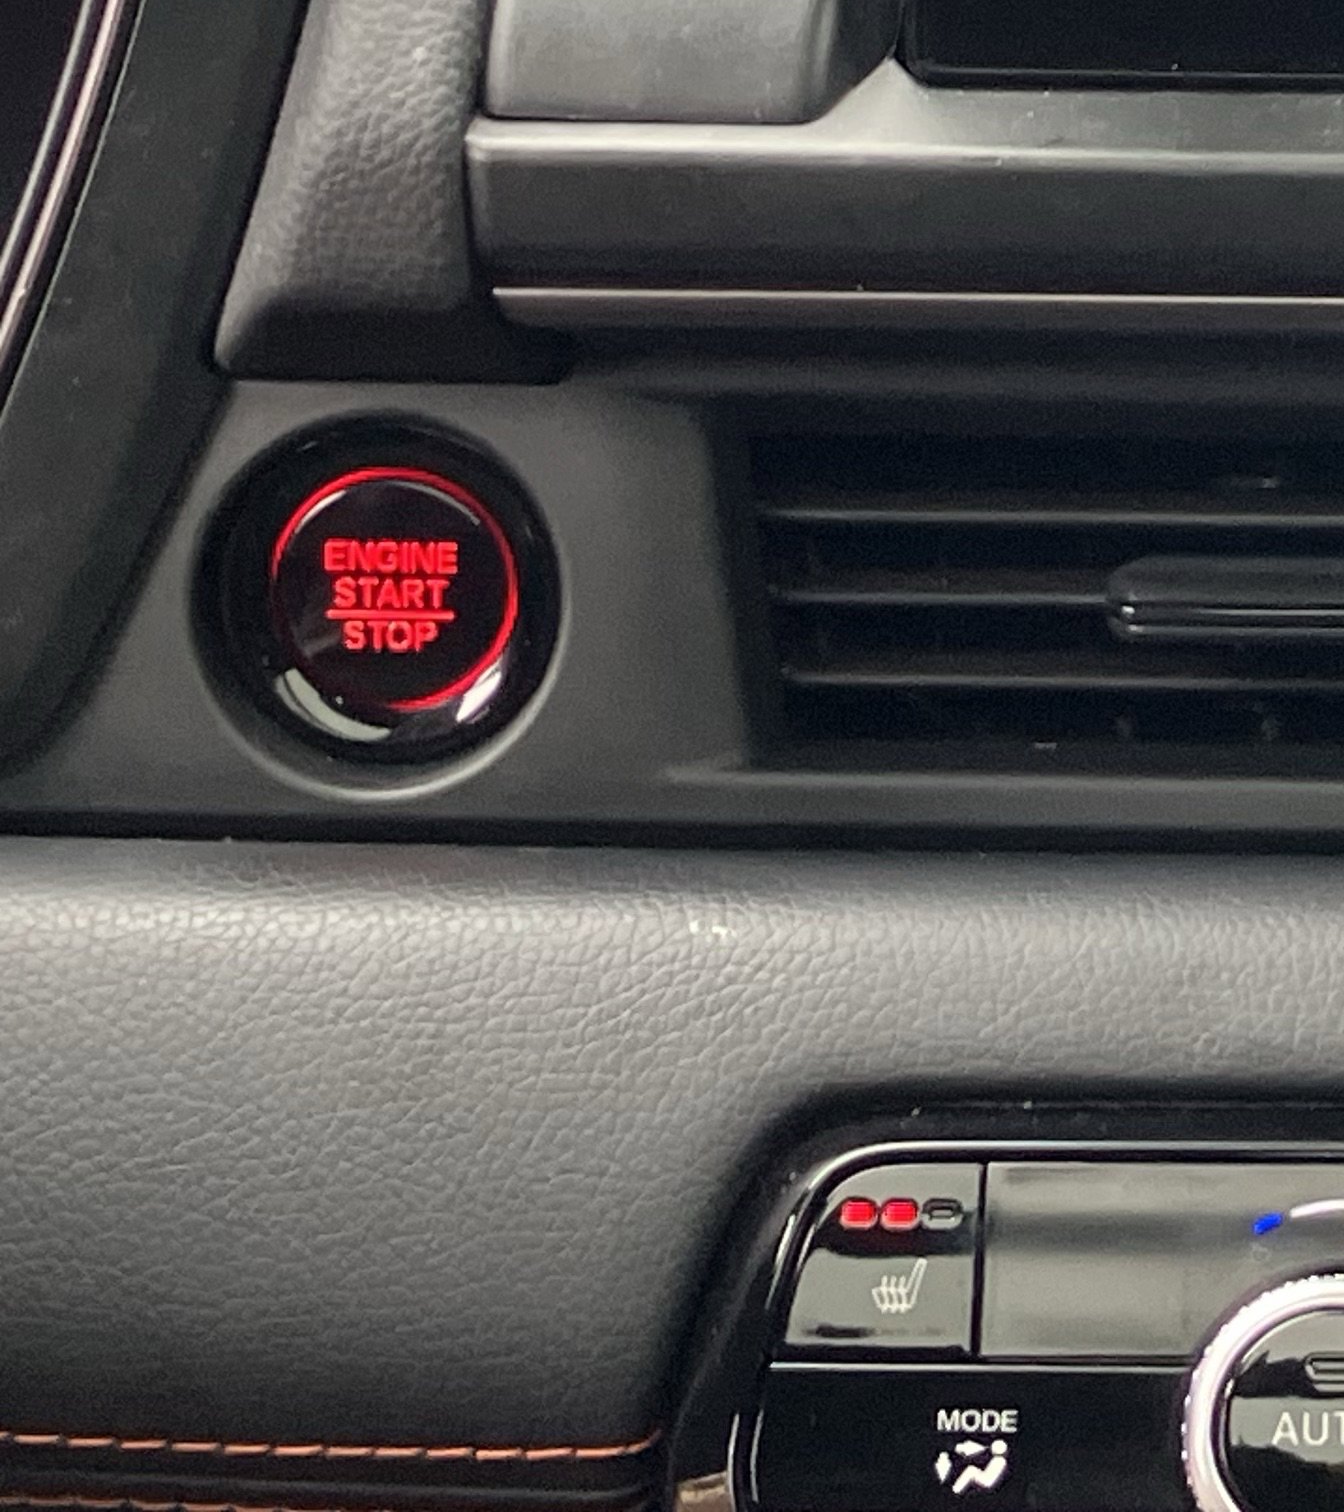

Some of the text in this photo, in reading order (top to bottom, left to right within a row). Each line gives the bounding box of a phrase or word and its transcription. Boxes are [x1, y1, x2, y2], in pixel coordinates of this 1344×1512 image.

[323, 540, 459, 574] ENGINE
[333, 576, 450, 608] START
[343, 621, 439, 650] STOP
[934, 1407, 1020, 1434] MODE
